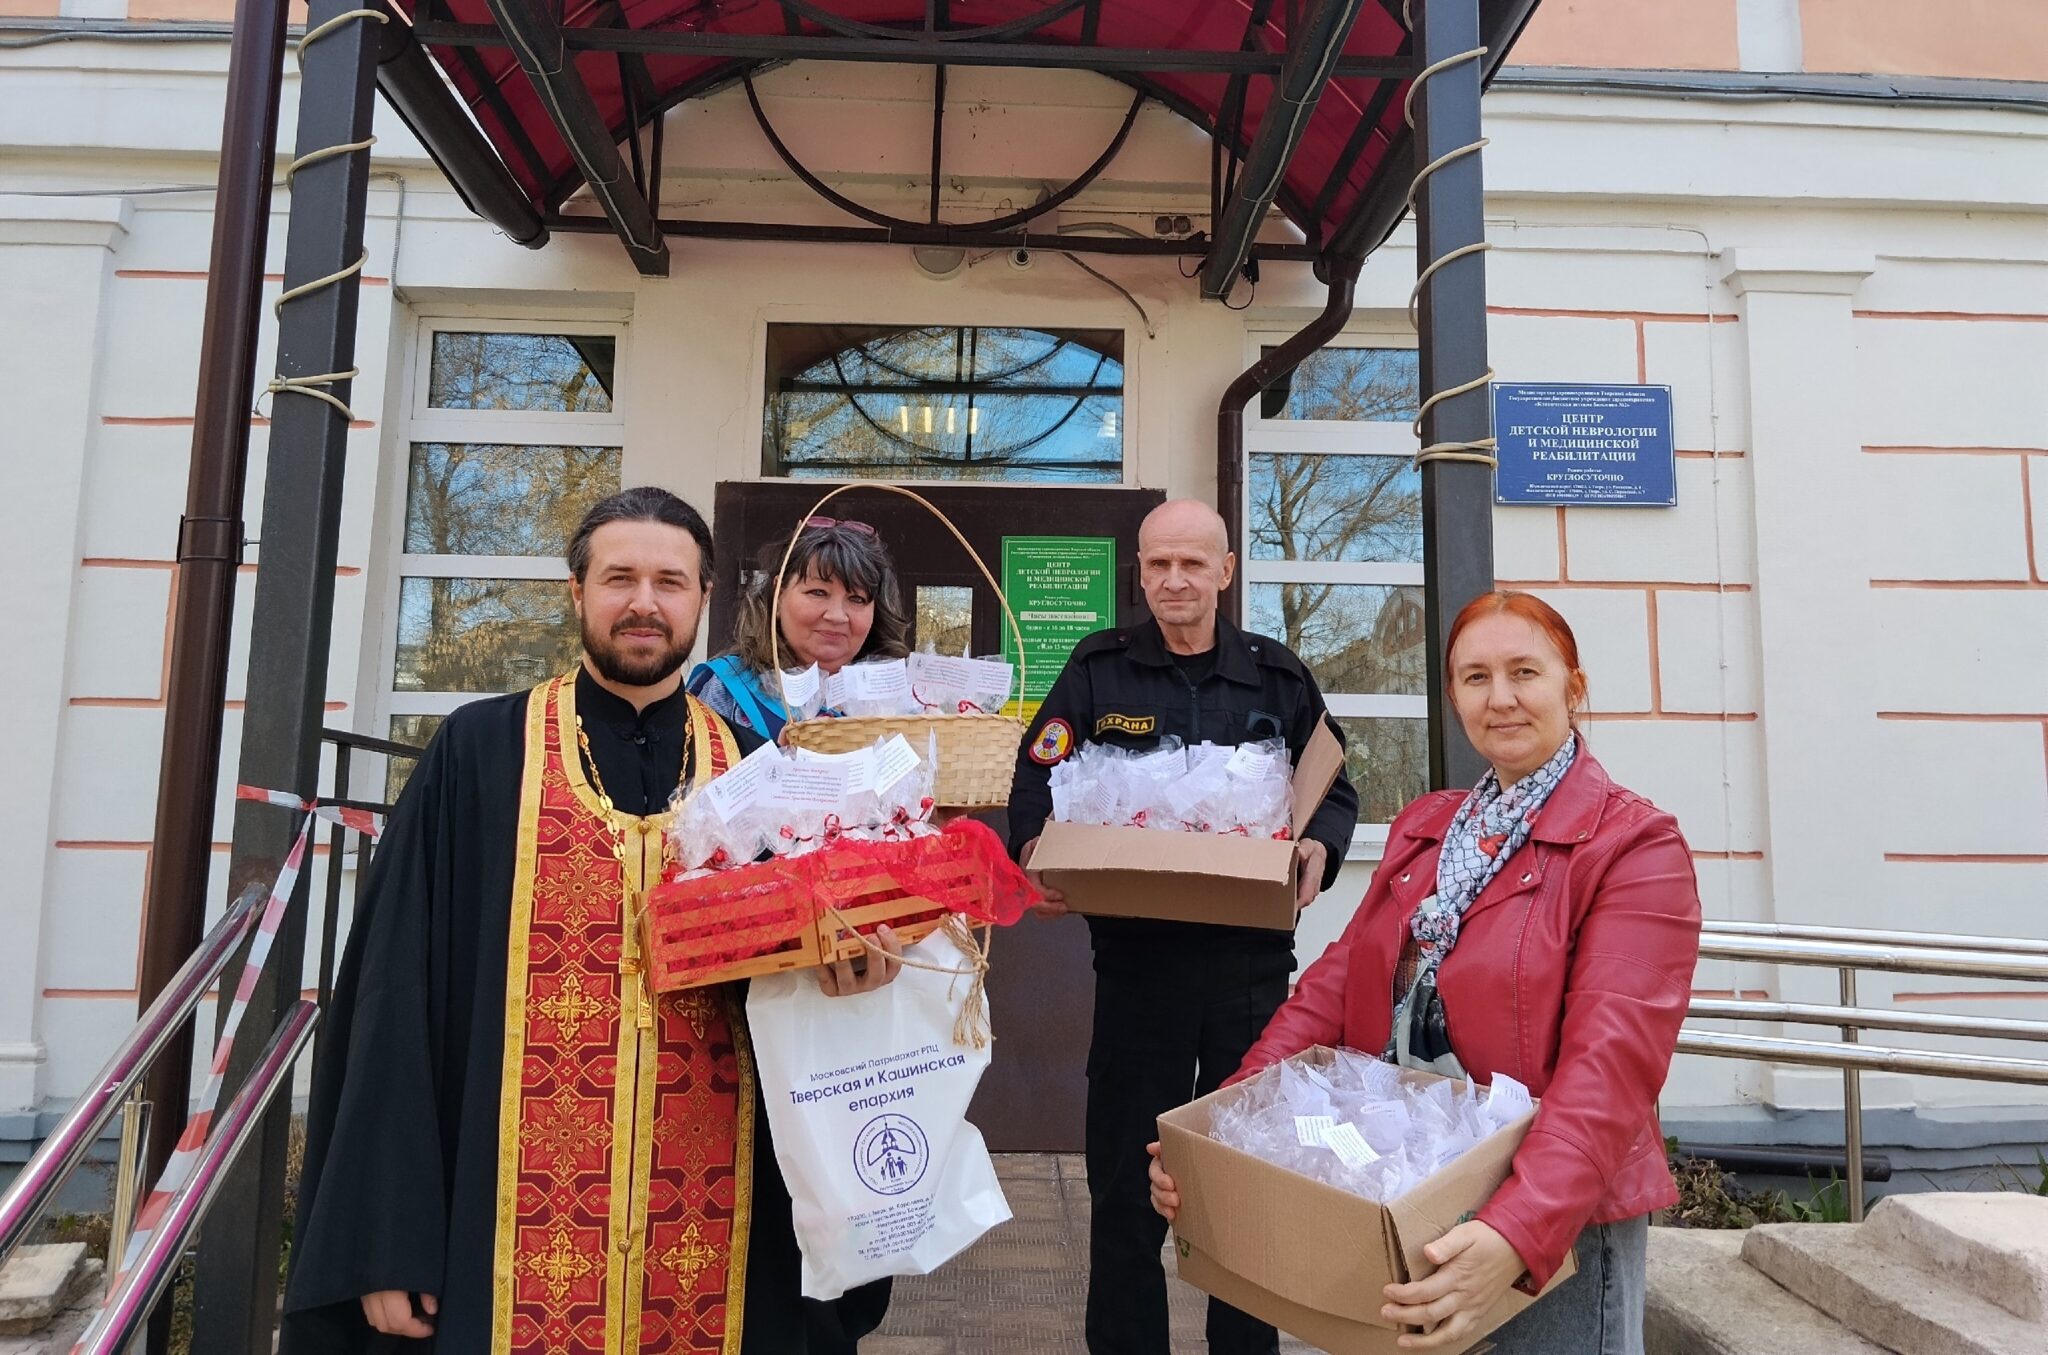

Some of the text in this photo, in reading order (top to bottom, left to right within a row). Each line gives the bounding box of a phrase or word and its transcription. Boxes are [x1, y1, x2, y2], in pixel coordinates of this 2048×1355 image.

[1562, 414, 1604, 424] ЦЕНТР
[1509, 425, 1657, 437] ДЕТСКОЙ НЕВРОЛОГИИ
[1528, 438, 1640, 449] И МЕДИЦИНСКОЙ
[1533, 450, 1636, 462] РЕАБИЛИТАЦИИ
[1546, 473, 1624, 481] КРУГЛОСУТОЧНО
[1046, 561, 1071, 569] ЦЕНТР
[809, 1044, 940, 1082] Московский Патриархат РПЦ
[790, 1053, 966, 1105] Тверская и Кашинская
[848, 1086, 915, 1112] епархия
